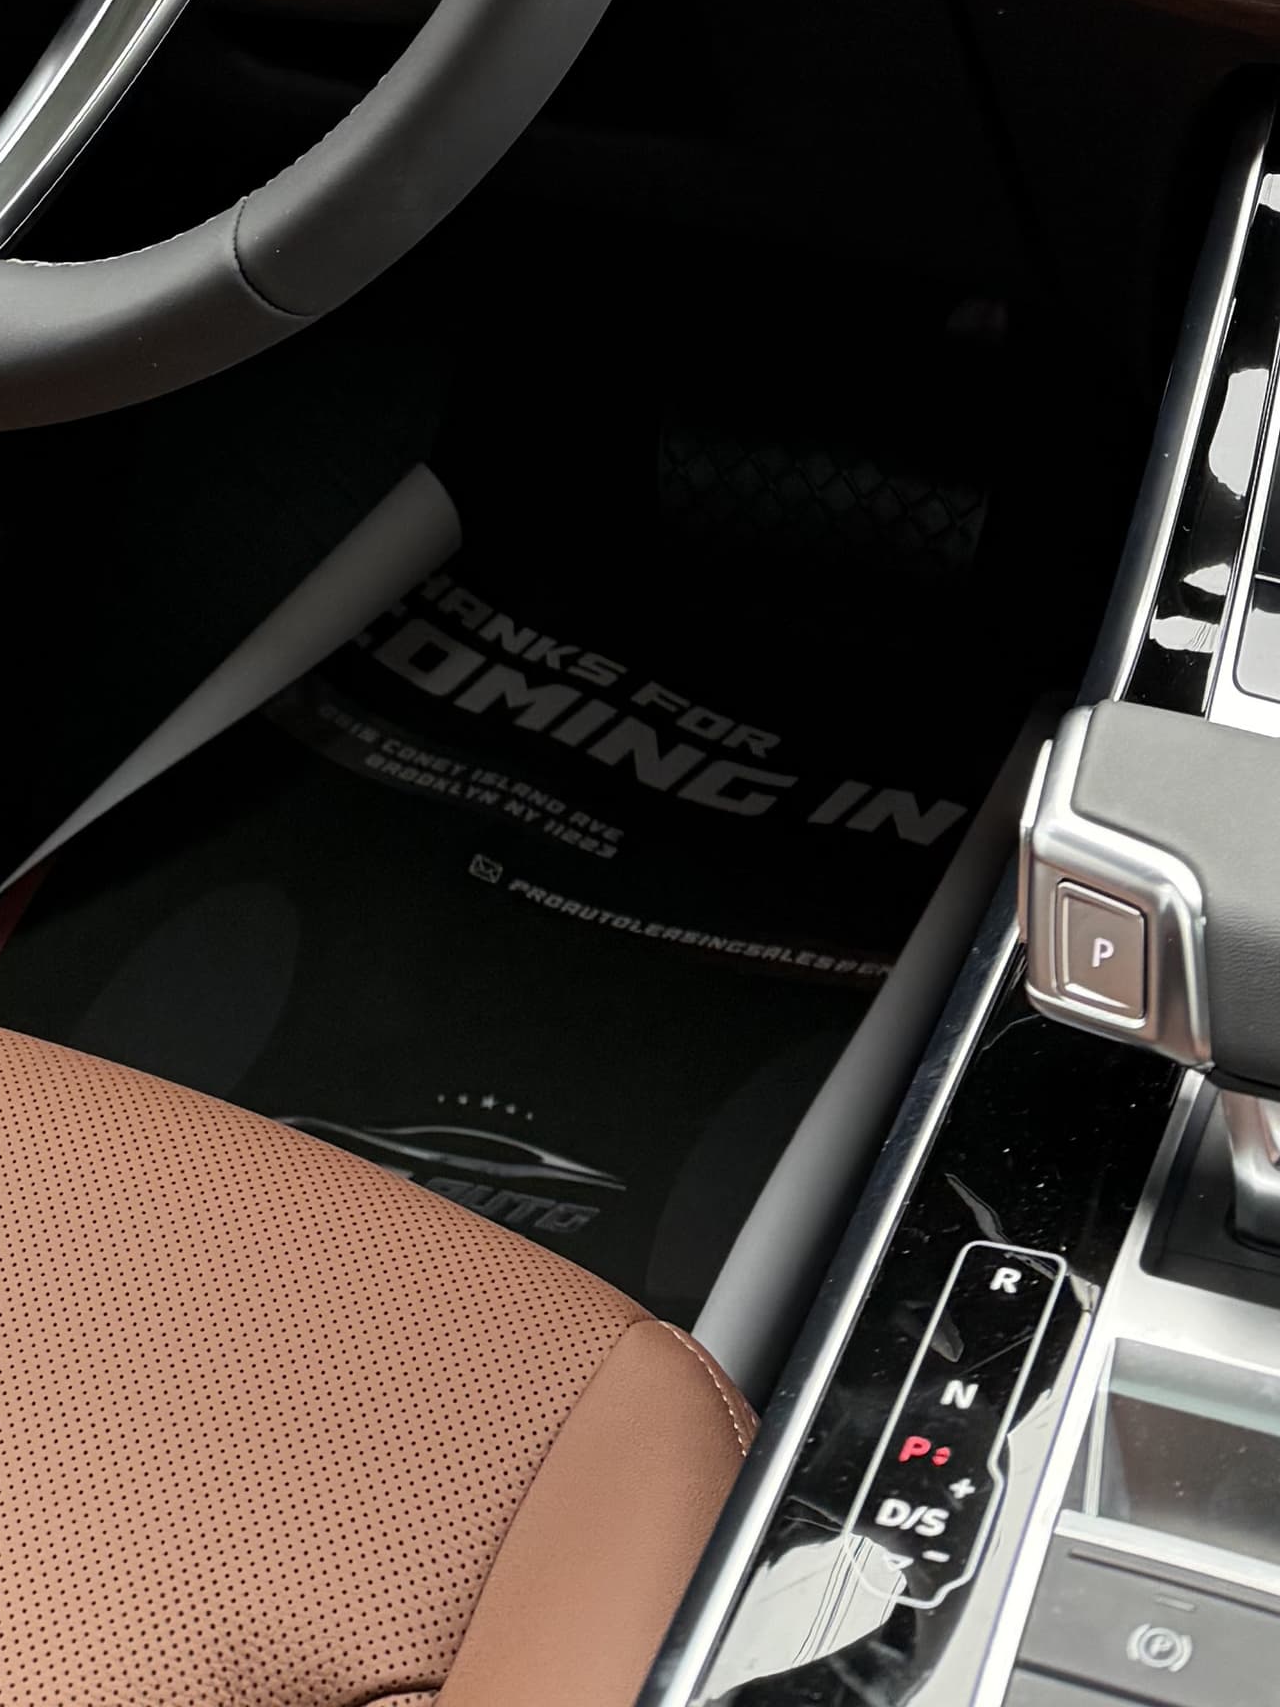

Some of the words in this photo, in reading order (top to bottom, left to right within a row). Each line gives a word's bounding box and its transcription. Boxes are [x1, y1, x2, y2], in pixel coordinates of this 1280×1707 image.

[352, 598, 799, 817] OMING
[807, 780, 968, 847] IN
[630, 679, 784, 758] FOR
[364, 753, 501, 806] BROOKLYN
[503, 799, 542, 823] NY
[470, 768, 567, 816] ISLAND
[568, 810, 625, 844] AVE
[1093, 938, 1113, 967] P
[991, 1268, 1021, 1293] R
[941, 1380, 978, 1408] N
[899, 1436, 931, 1463] P
[877, 1499, 948, 1536] D/S
